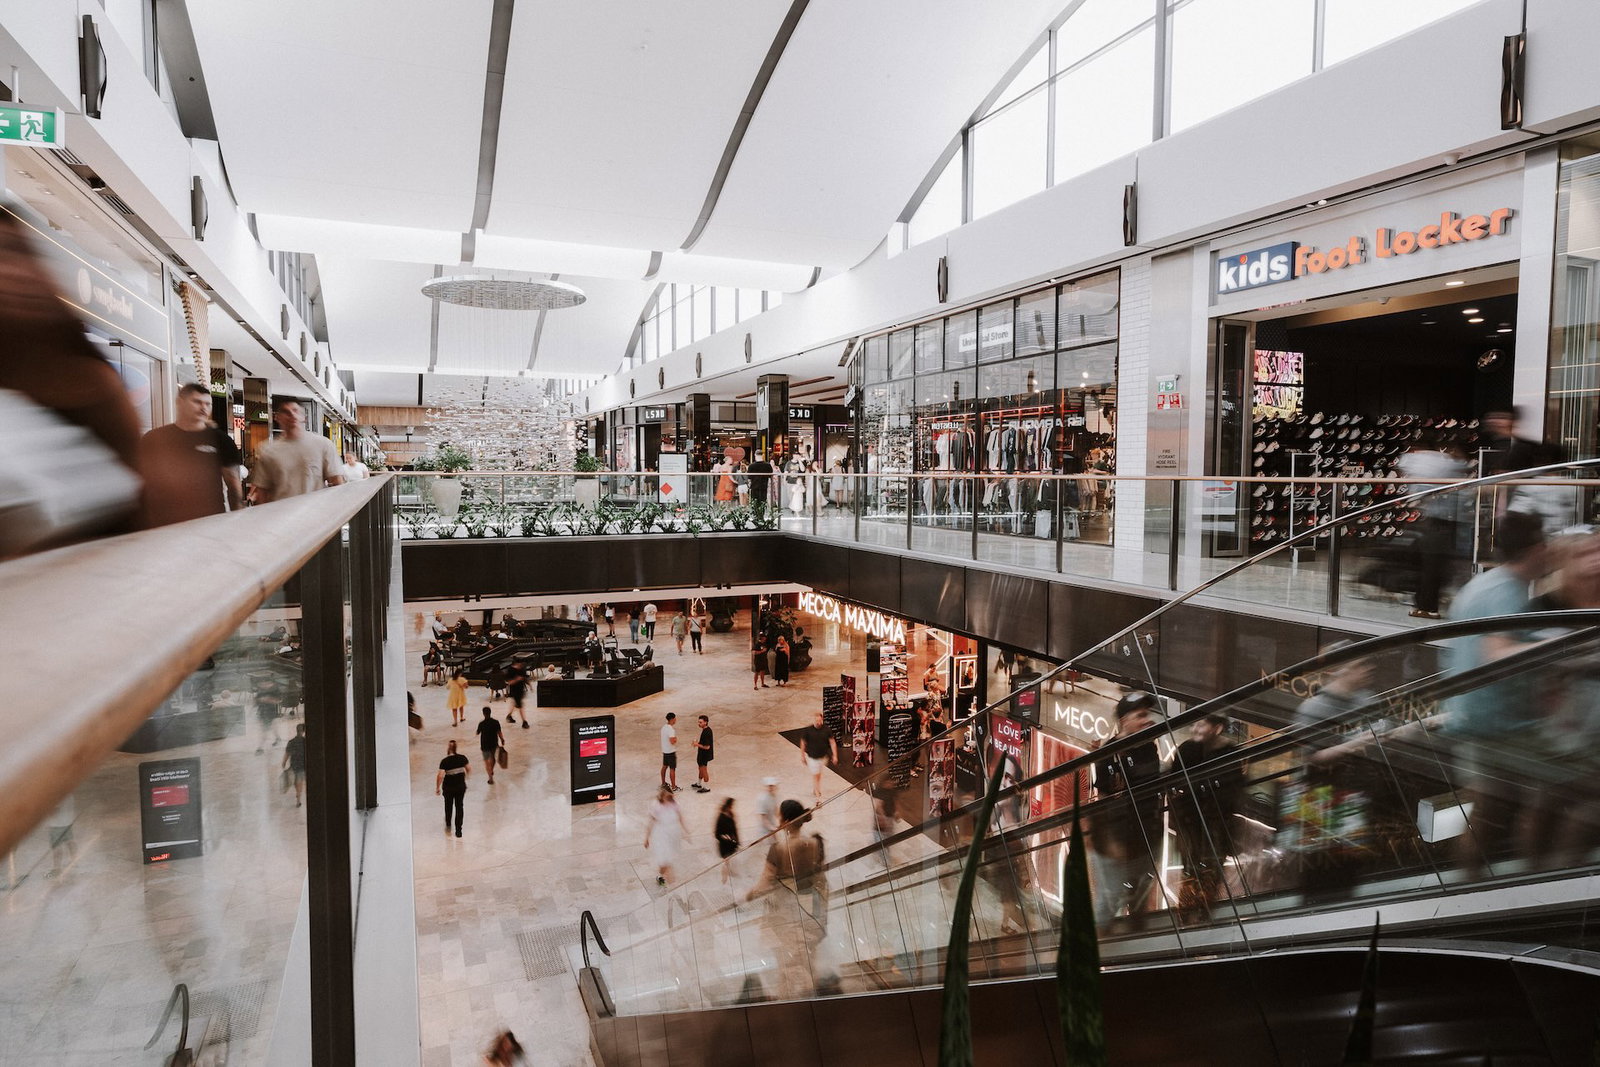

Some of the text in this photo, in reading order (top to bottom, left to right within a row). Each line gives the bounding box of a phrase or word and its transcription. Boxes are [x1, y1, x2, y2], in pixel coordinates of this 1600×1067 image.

[1219, 252, 1288, 292] kids
[1376, 207, 1513, 259] Locker
[789, 409, 811, 418] SKD
[798, 591, 906, 646] MECCA MAXIMA
[1260, 667, 1322, 699] MECC
[998, 723, 1019, 741] LOVE
